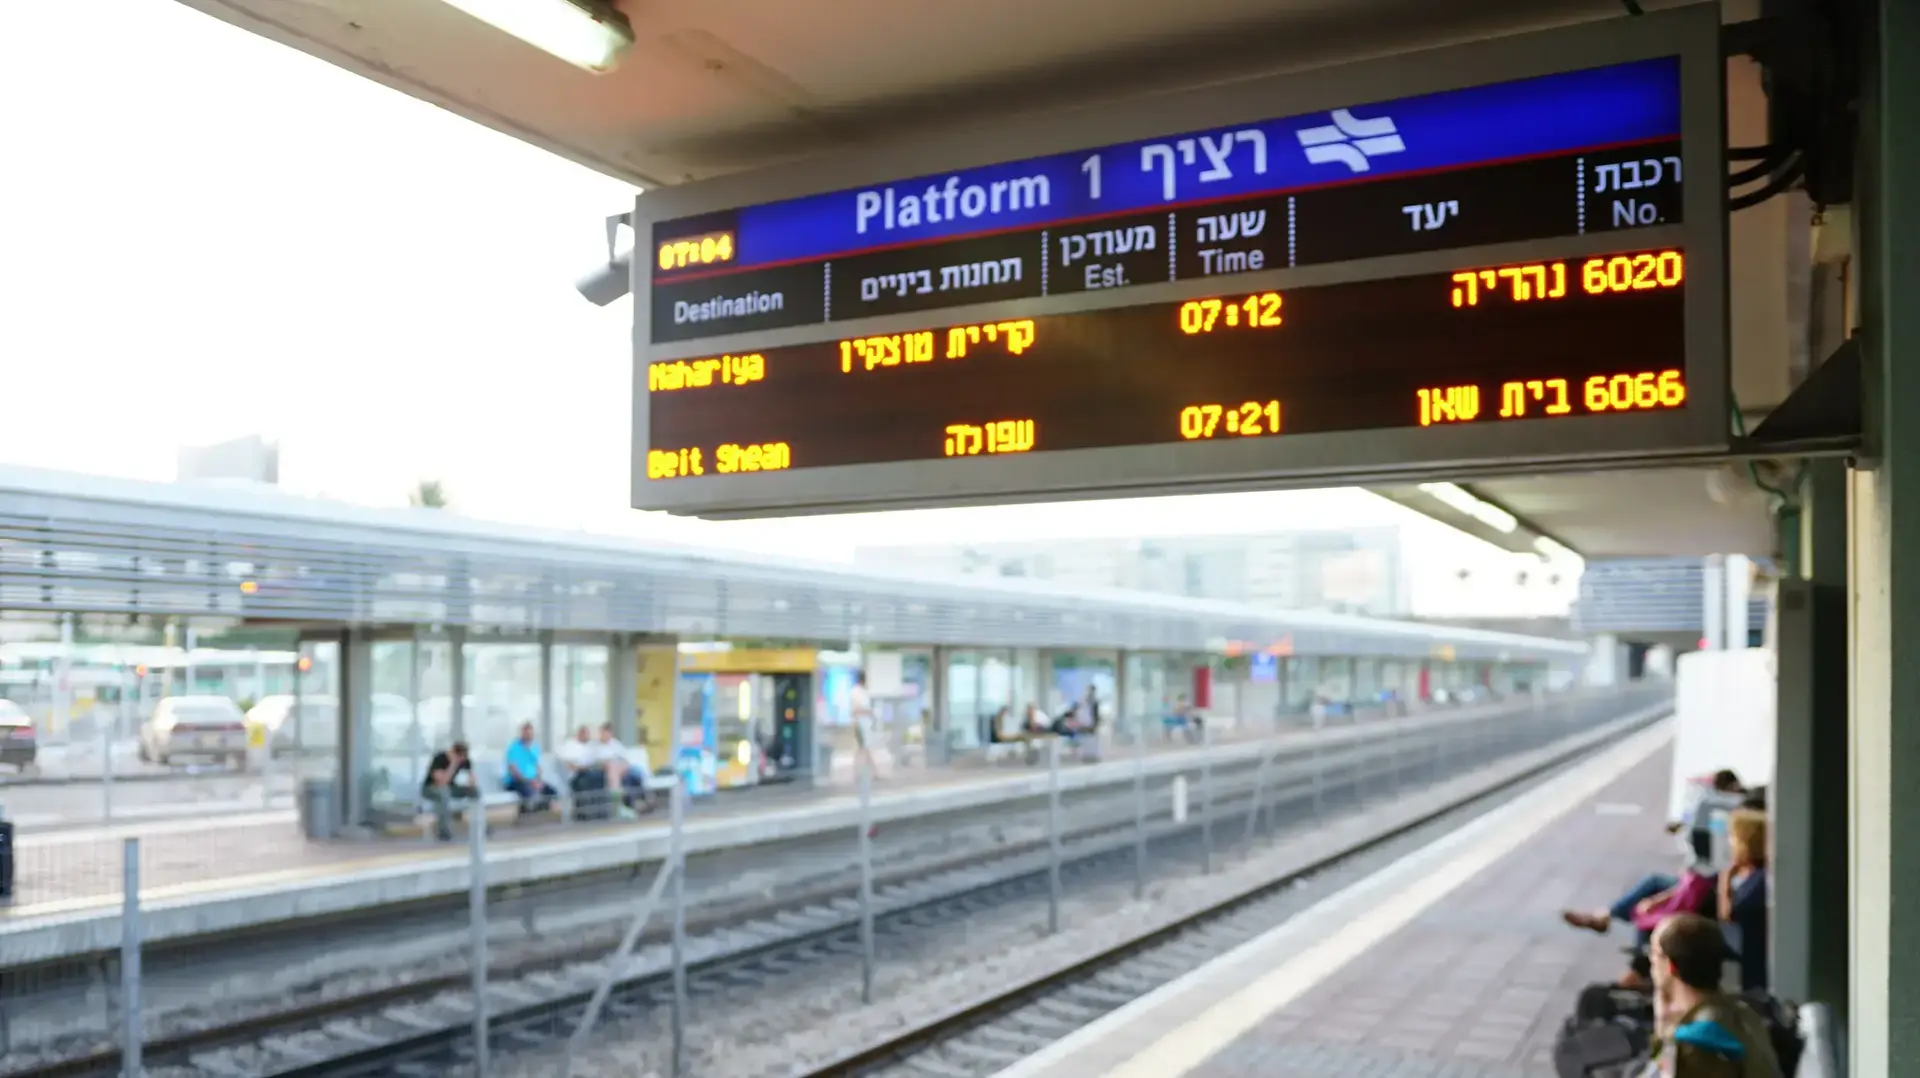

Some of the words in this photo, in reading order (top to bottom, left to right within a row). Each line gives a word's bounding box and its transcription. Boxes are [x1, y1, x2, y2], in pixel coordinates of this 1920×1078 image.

[1141, 129, 1267, 201] רציף
[1594, 156, 1682, 193] רכבת
[856, 174, 1050, 235] Platform
[1082, 154, 1101, 199] 1
[1612, 199, 1666, 227] No.
[1196, 209, 1266, 243] שעה
[1402, 200, 1459, 231] יעד
[659, 233, 733, 270] 07:04
[1059, 224, 1156, 267] מעודכן
[1198, 248, 1264, 275] Time
[861, 271, 933, 301] ביניים
[940, 257, 1022, 291] תחנות
[1085, 263, 1130, 289] Est.
[1452, 262, 1567, 308] נהריה
[1583, 251, 1683, 294] 6020
[674, 290, 783, 325] Destination
[1180, 293, 1282, 334] 07:12
[839, 332, 934, 373] מוצקין
[946, 319, 1035, 355] קריית
[647, 353, 765, 392] Nahariya
[1584, 369, 1685, 412] 6066
[1417, 385, 1480, 427] שאן
[1499, 378, 1572, 418] בית
[944, 419, 1035, 457] עפולה
[1180, 401, 1280, 439] 07:21
[646, 447, 705, 480] Beit
[716, 442, 791, 474] Shean
